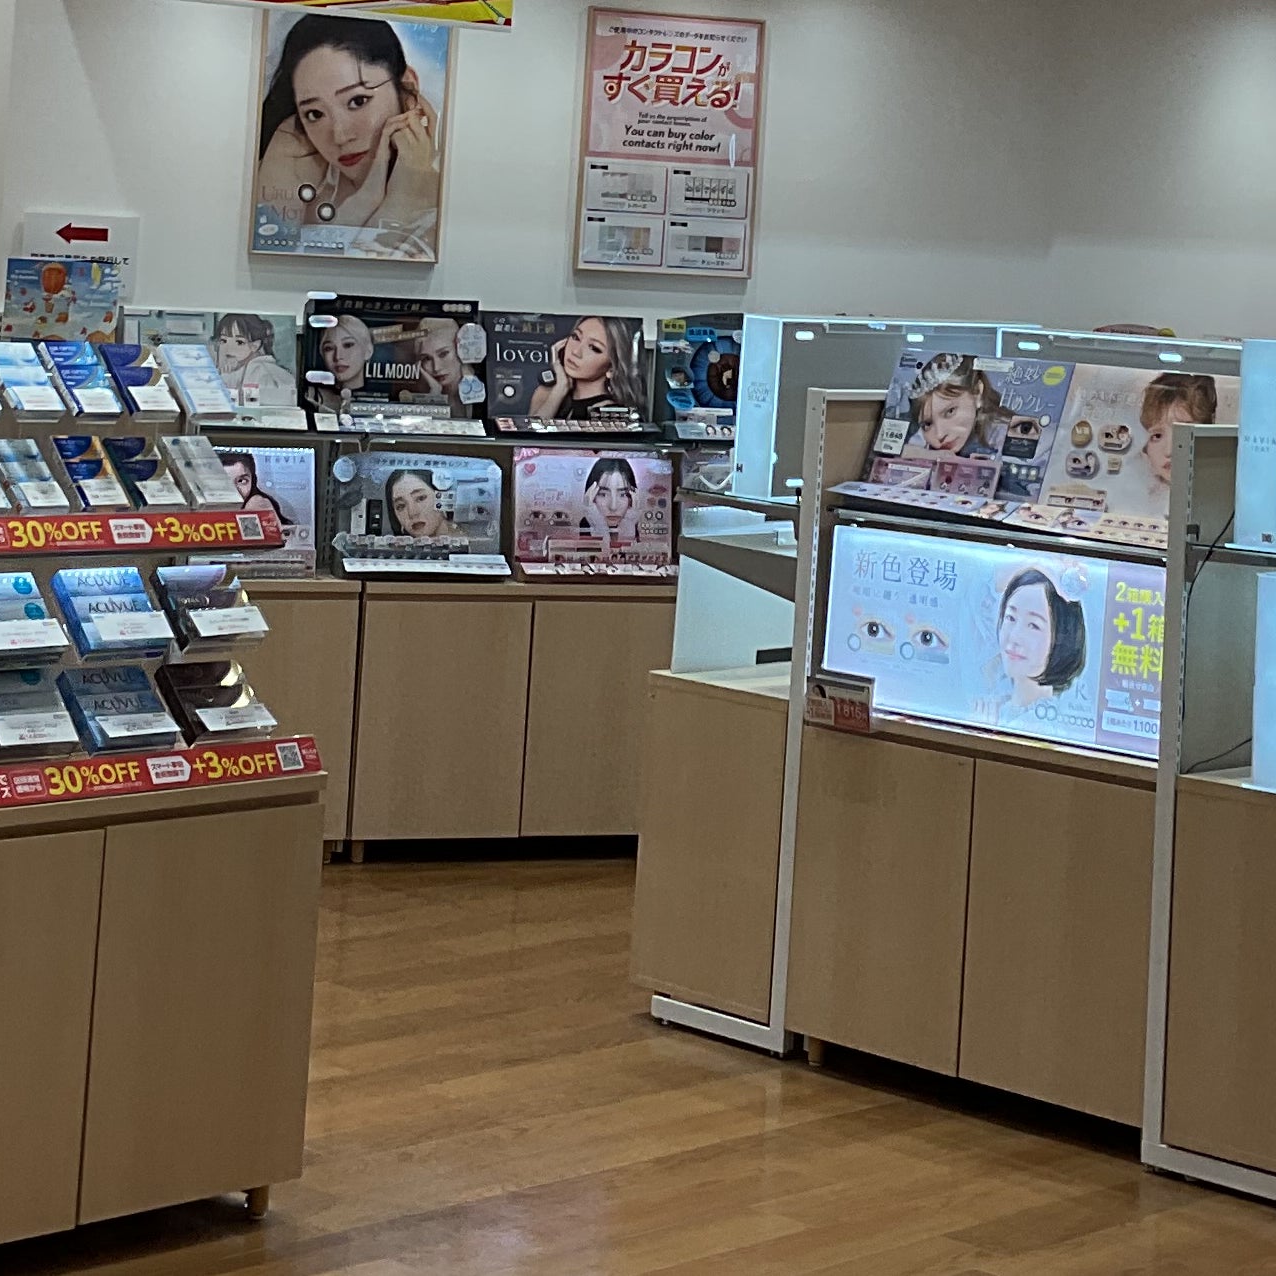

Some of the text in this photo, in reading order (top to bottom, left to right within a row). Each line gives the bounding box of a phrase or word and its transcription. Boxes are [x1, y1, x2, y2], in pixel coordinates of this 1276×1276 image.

[620, 40, 731, 77] カラコンが
[622, 138, 721, 154] contacts right now!
[625, 125, 715, 142] You can buy color
[365, 362, 421, 380] LIL MOON
[7, 520, 103, 548] 30%OFF
[154, 516, 238, 543] +3%OFF
[77, 575, 132, 588] ACUVUE
[854, 549, 958, 592] 新色登場
[88, 599, 143, 613] ACUVUE
[1110, 640, 1163, 681] 無料
[44, 761, 140, 796] 30%OFF
[192, 751, 277, 779] +3%OFF
